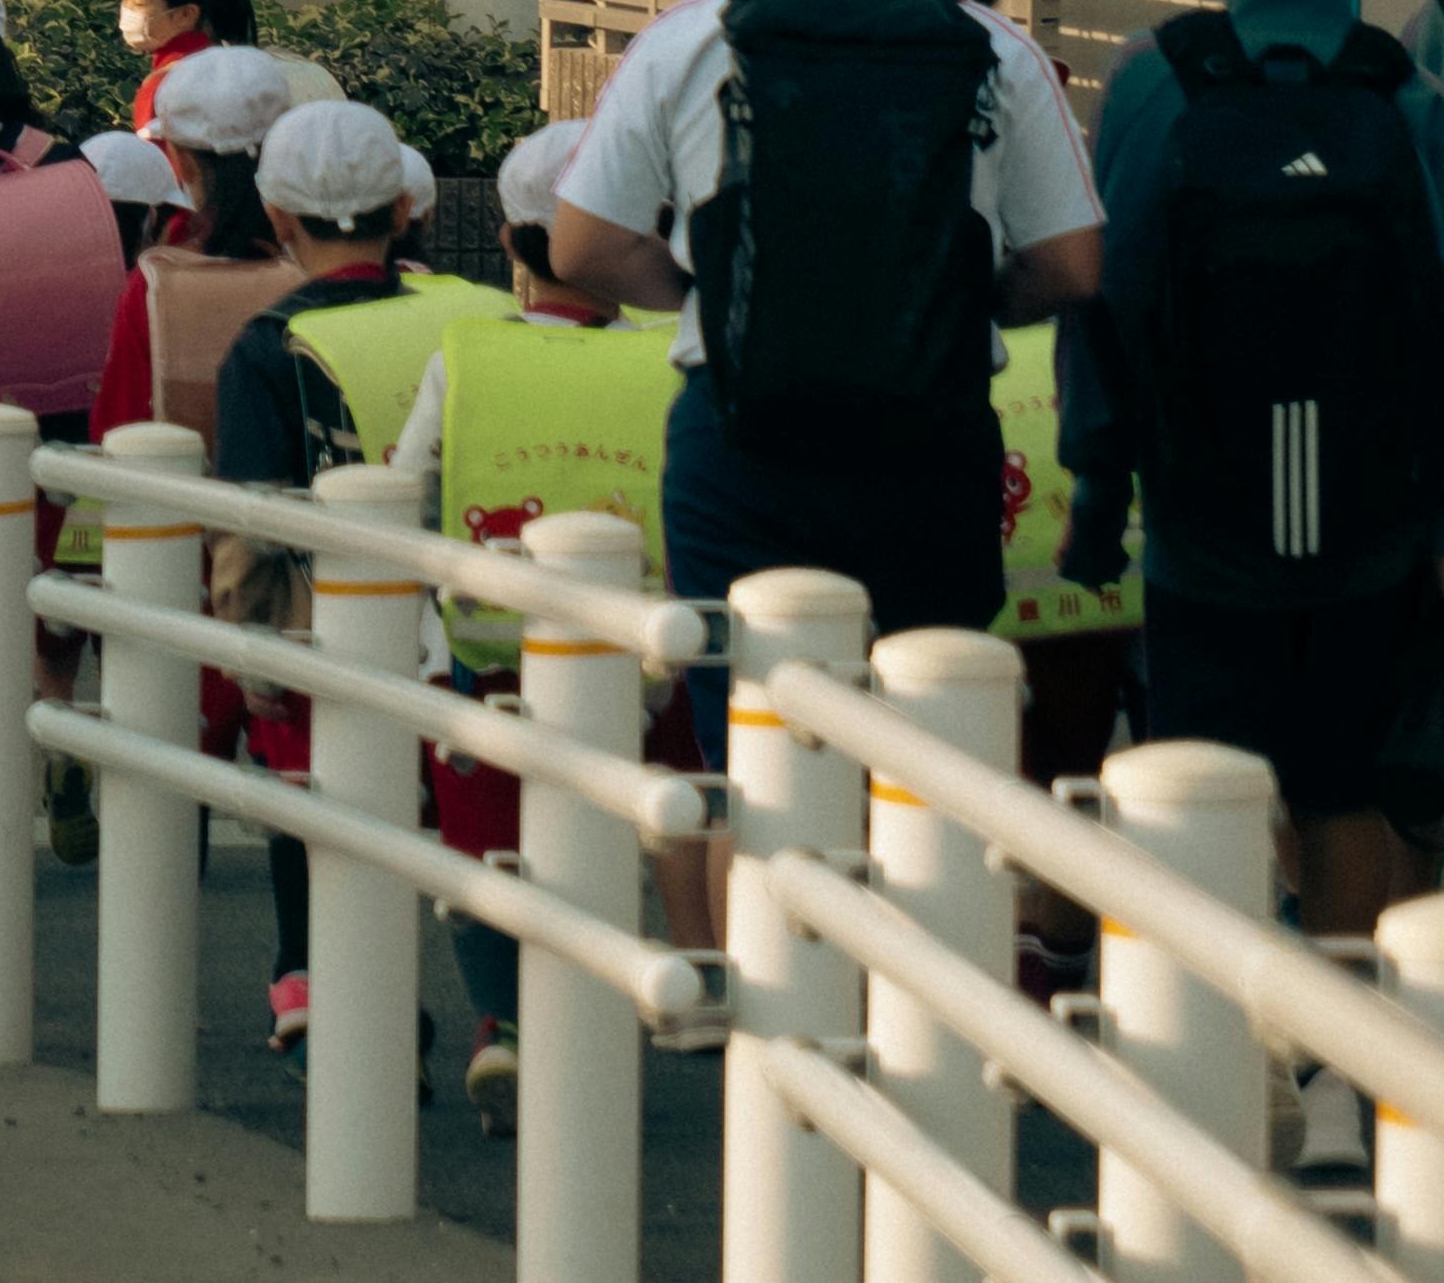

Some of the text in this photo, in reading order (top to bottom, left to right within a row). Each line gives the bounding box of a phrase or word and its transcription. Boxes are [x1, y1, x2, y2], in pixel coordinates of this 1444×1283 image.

[494, 441, 647, 472] こうつうあんぜん
